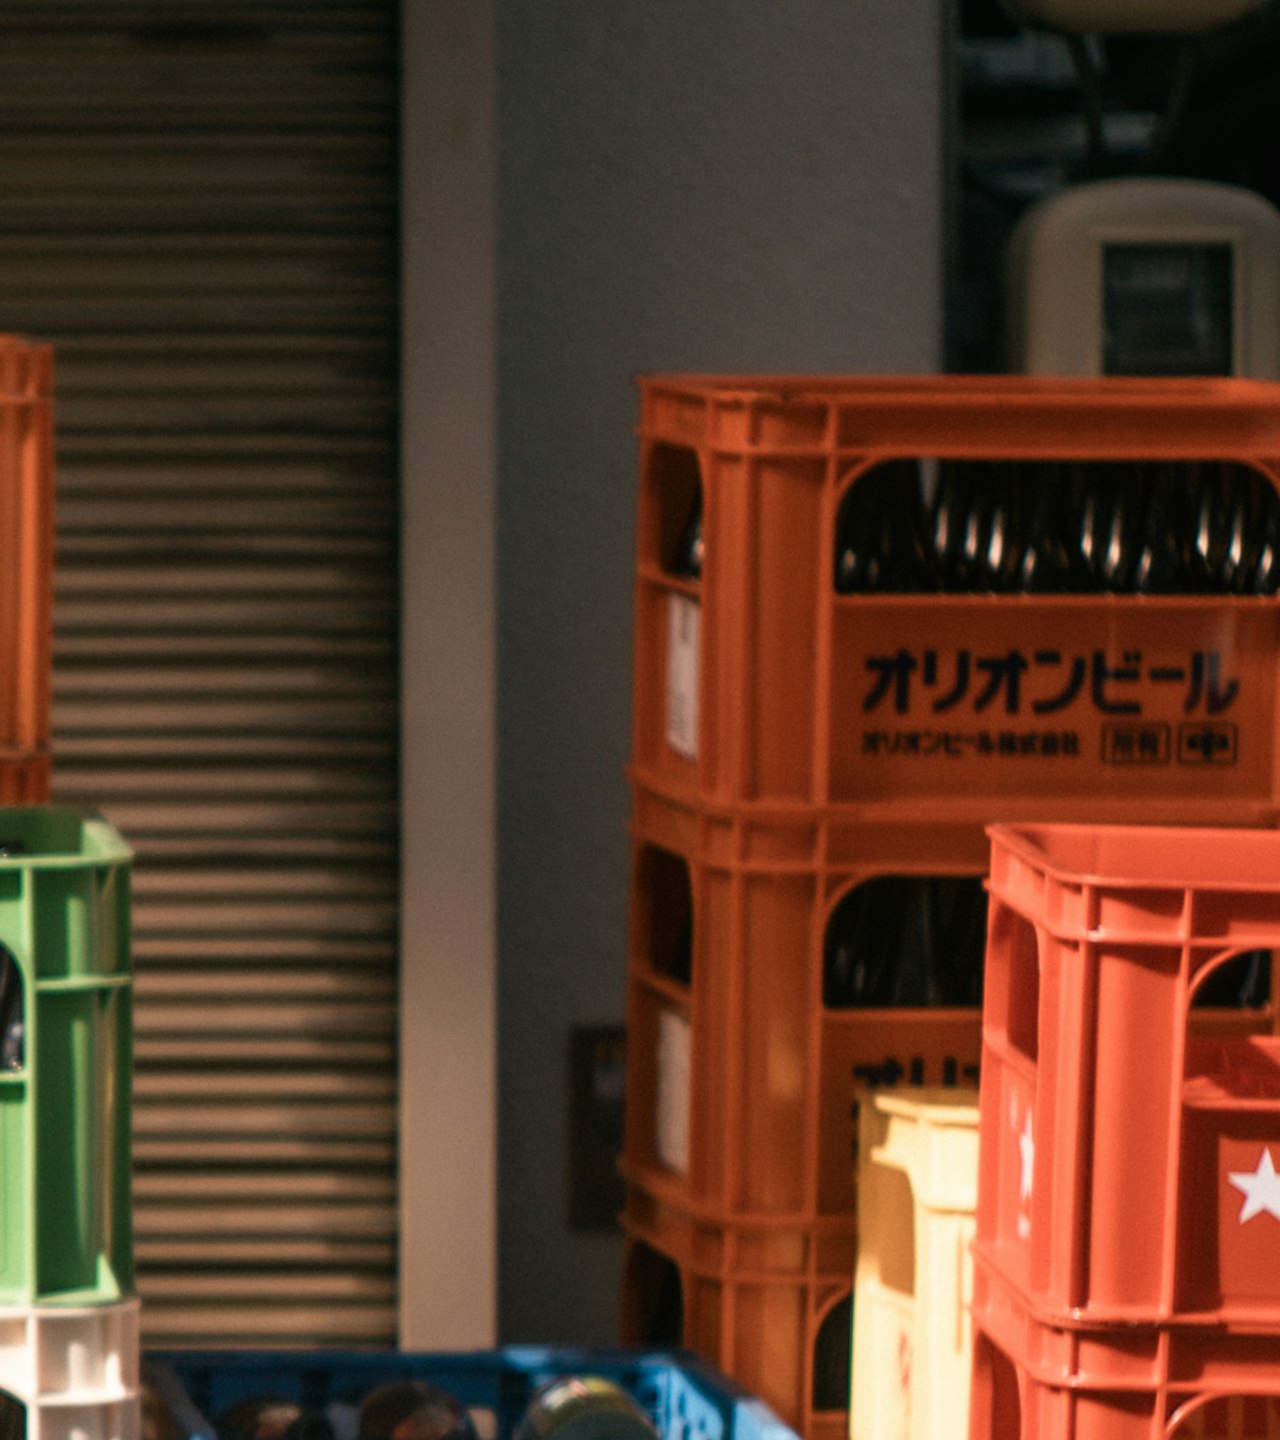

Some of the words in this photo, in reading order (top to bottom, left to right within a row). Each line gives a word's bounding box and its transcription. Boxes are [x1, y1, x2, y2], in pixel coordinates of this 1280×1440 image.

[863, 649, 1238, 714] オリオンビール
